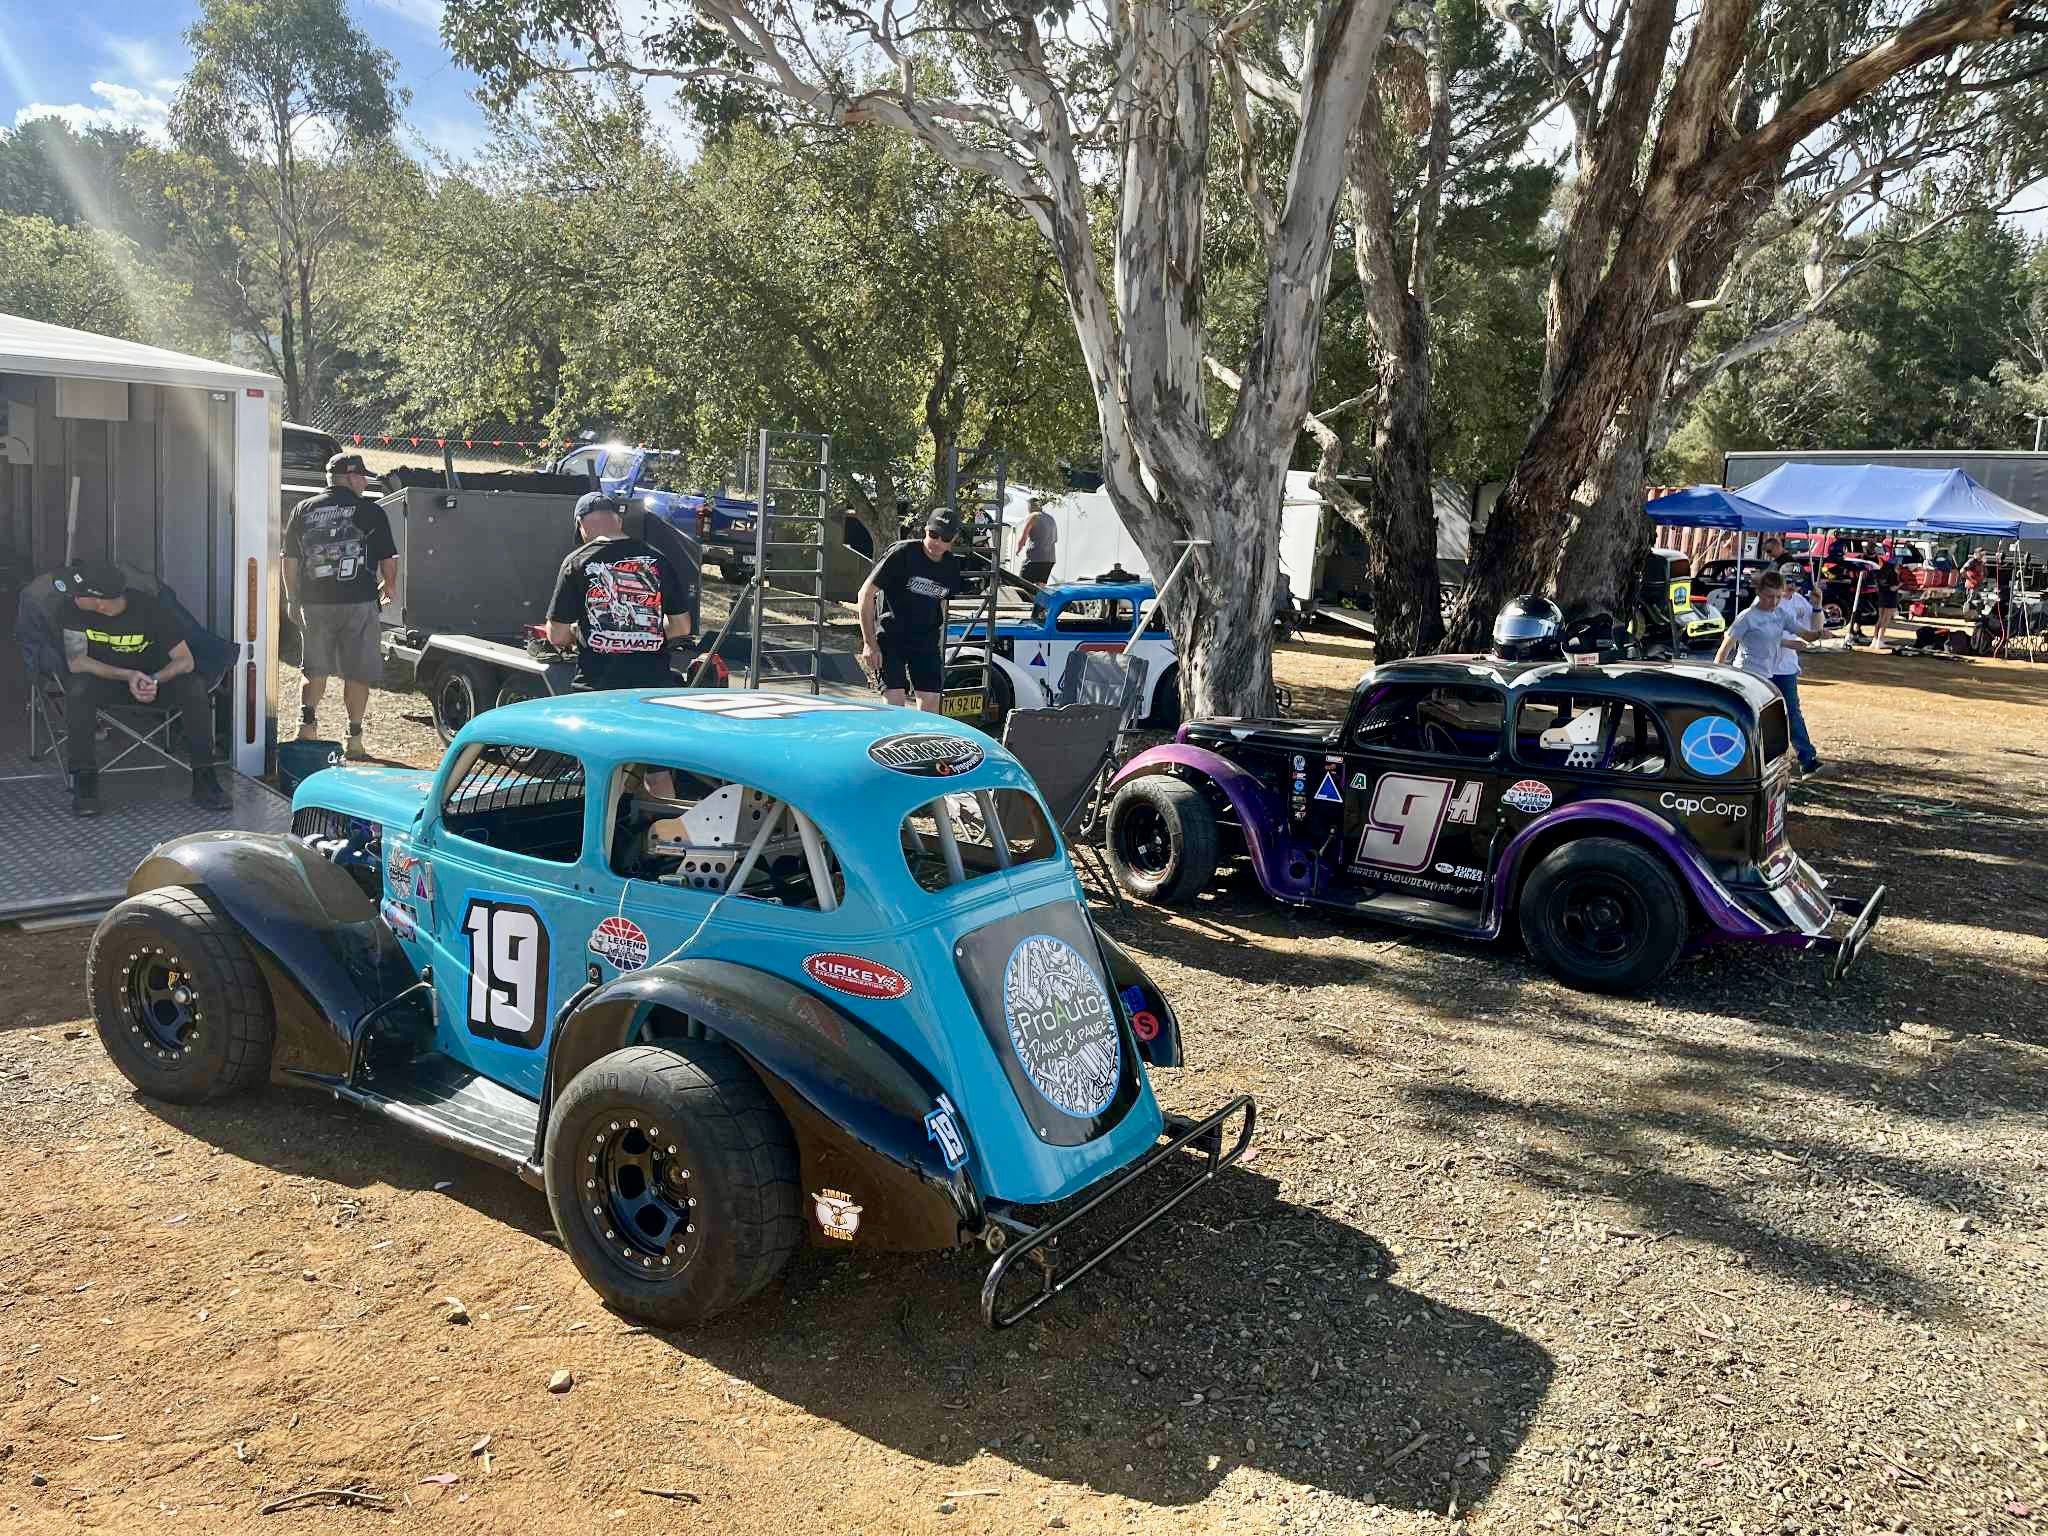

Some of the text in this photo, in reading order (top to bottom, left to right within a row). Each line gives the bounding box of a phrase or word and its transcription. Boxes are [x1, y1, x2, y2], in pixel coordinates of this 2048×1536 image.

[592, 634, 661, 650] STEWART
[957, 697, 969, 712] 92
[1659, 791, 1748, 821] CapCorp
[1453, 871, 1482, 881] SERIES
[1456, 865, 1484, 877] SUPER
[607, 935, 647, 951] LEGEND
[464, 901, 548, 1042] 19
[814, 959, 888, 985] KIRKEY
[1017, 994, 1100, 1040] ProAuto
[1064, 1028, 1078, 1051] &
[929, 1112, 967, 1162] 19
[821, 1188, 852, 1203] SMART
[822, 1223, 854, 1241] SIGNS
